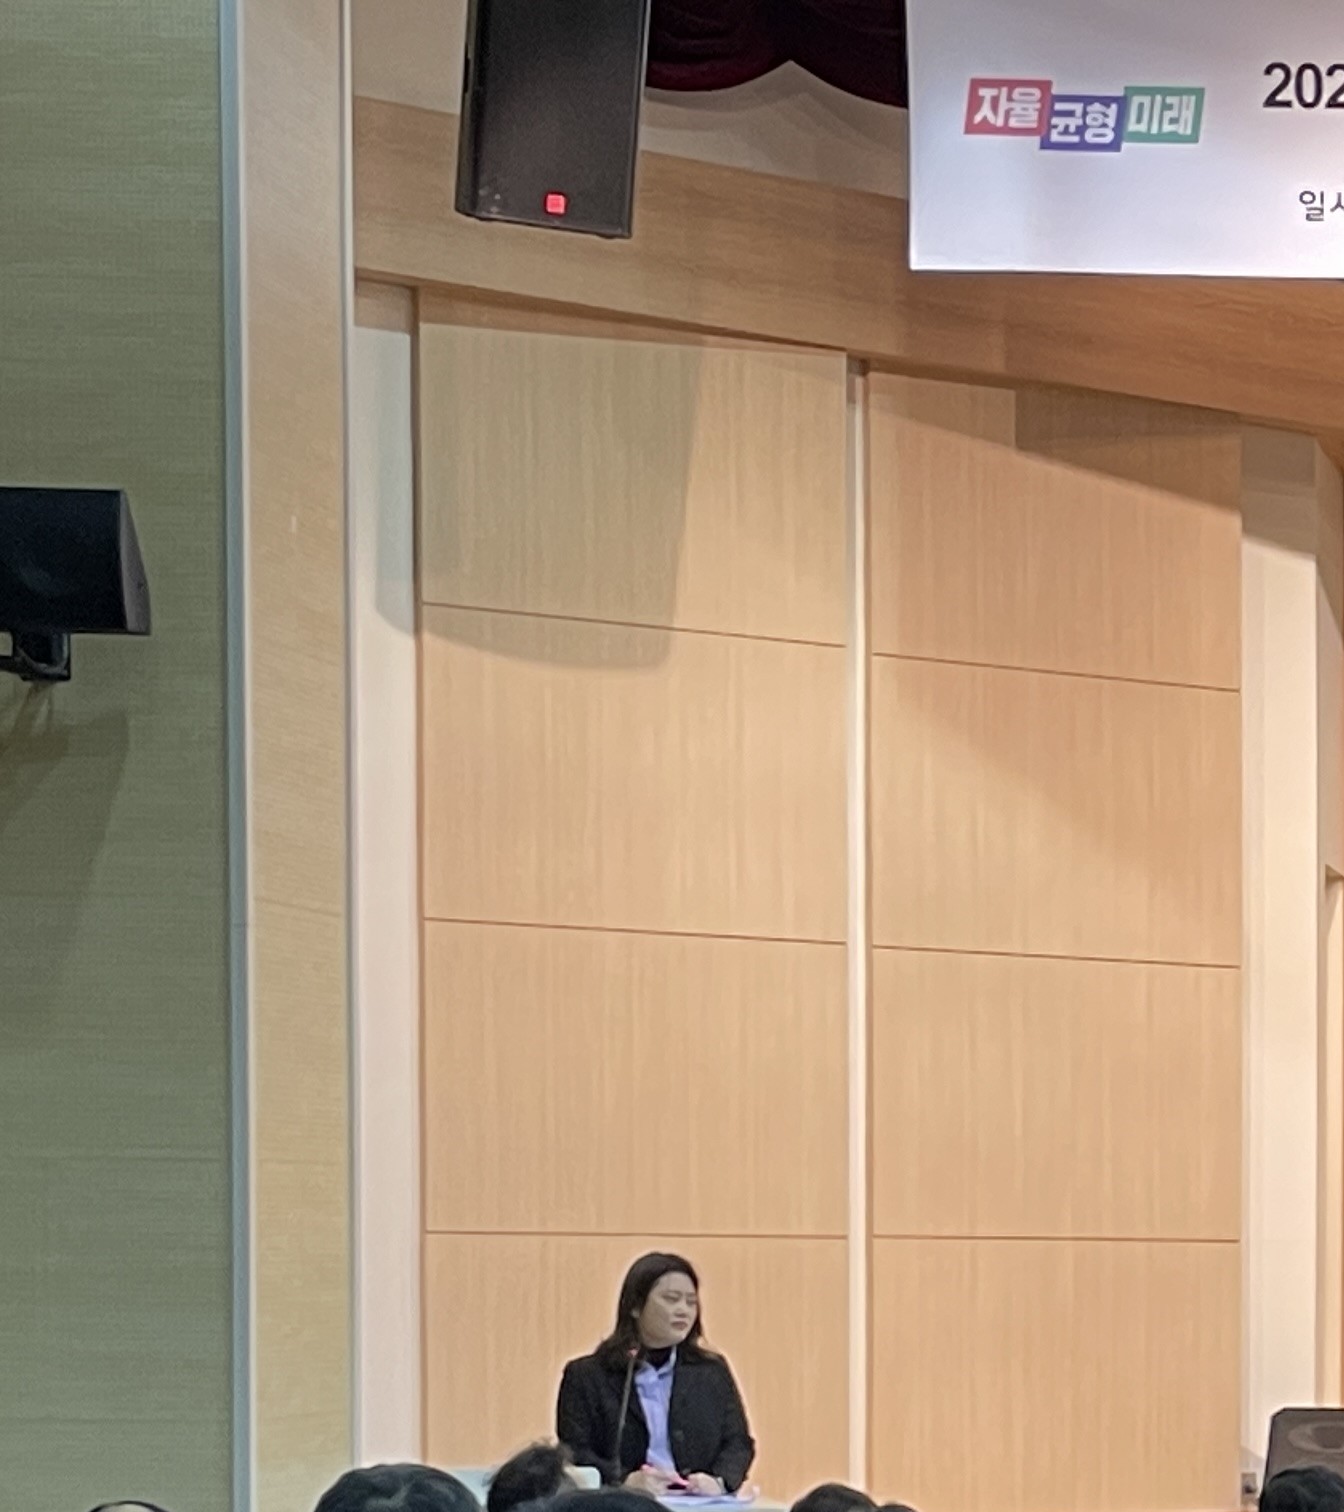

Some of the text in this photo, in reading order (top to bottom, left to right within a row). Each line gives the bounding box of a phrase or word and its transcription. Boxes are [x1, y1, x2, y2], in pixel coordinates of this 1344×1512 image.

[972, 86, 1197, 144] 자율 균형 미래
